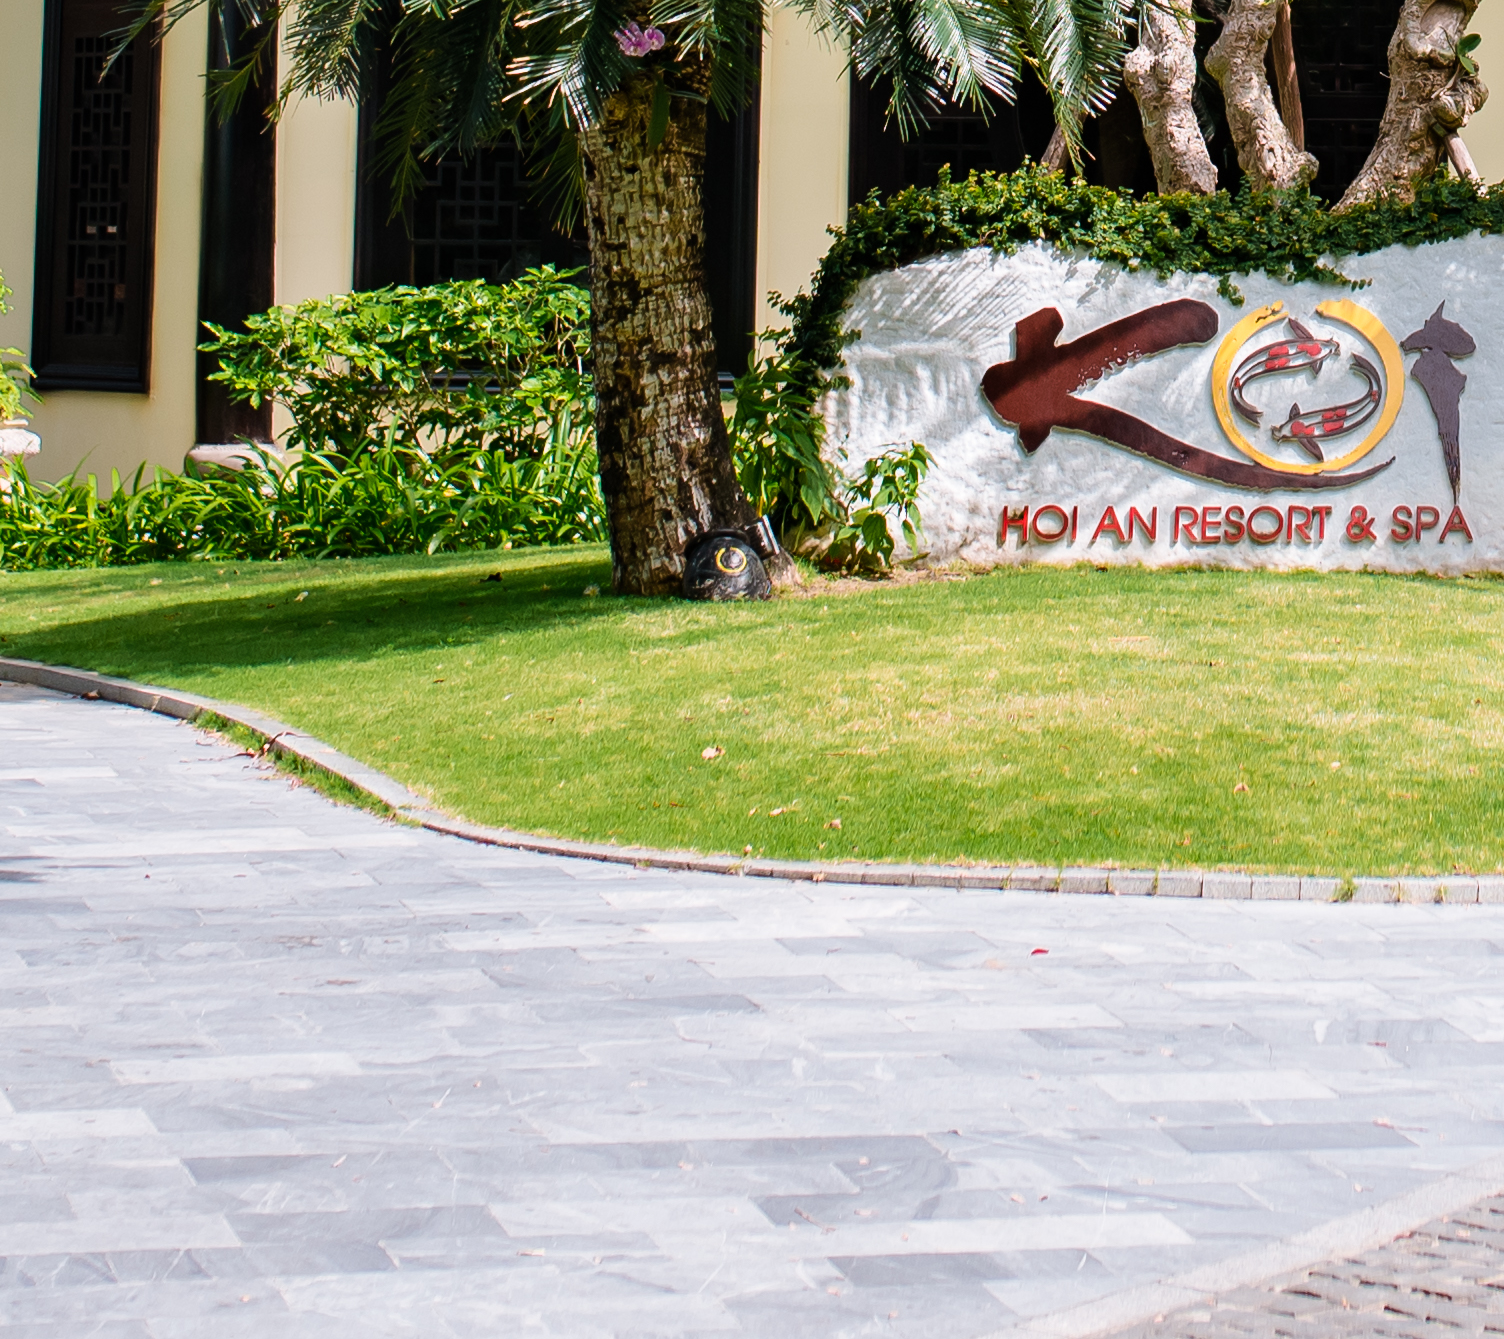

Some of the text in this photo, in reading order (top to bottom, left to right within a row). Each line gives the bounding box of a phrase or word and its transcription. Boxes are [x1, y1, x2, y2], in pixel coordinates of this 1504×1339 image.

[1000, 504, 1474, 544] HOI AN RESORT & SPA
